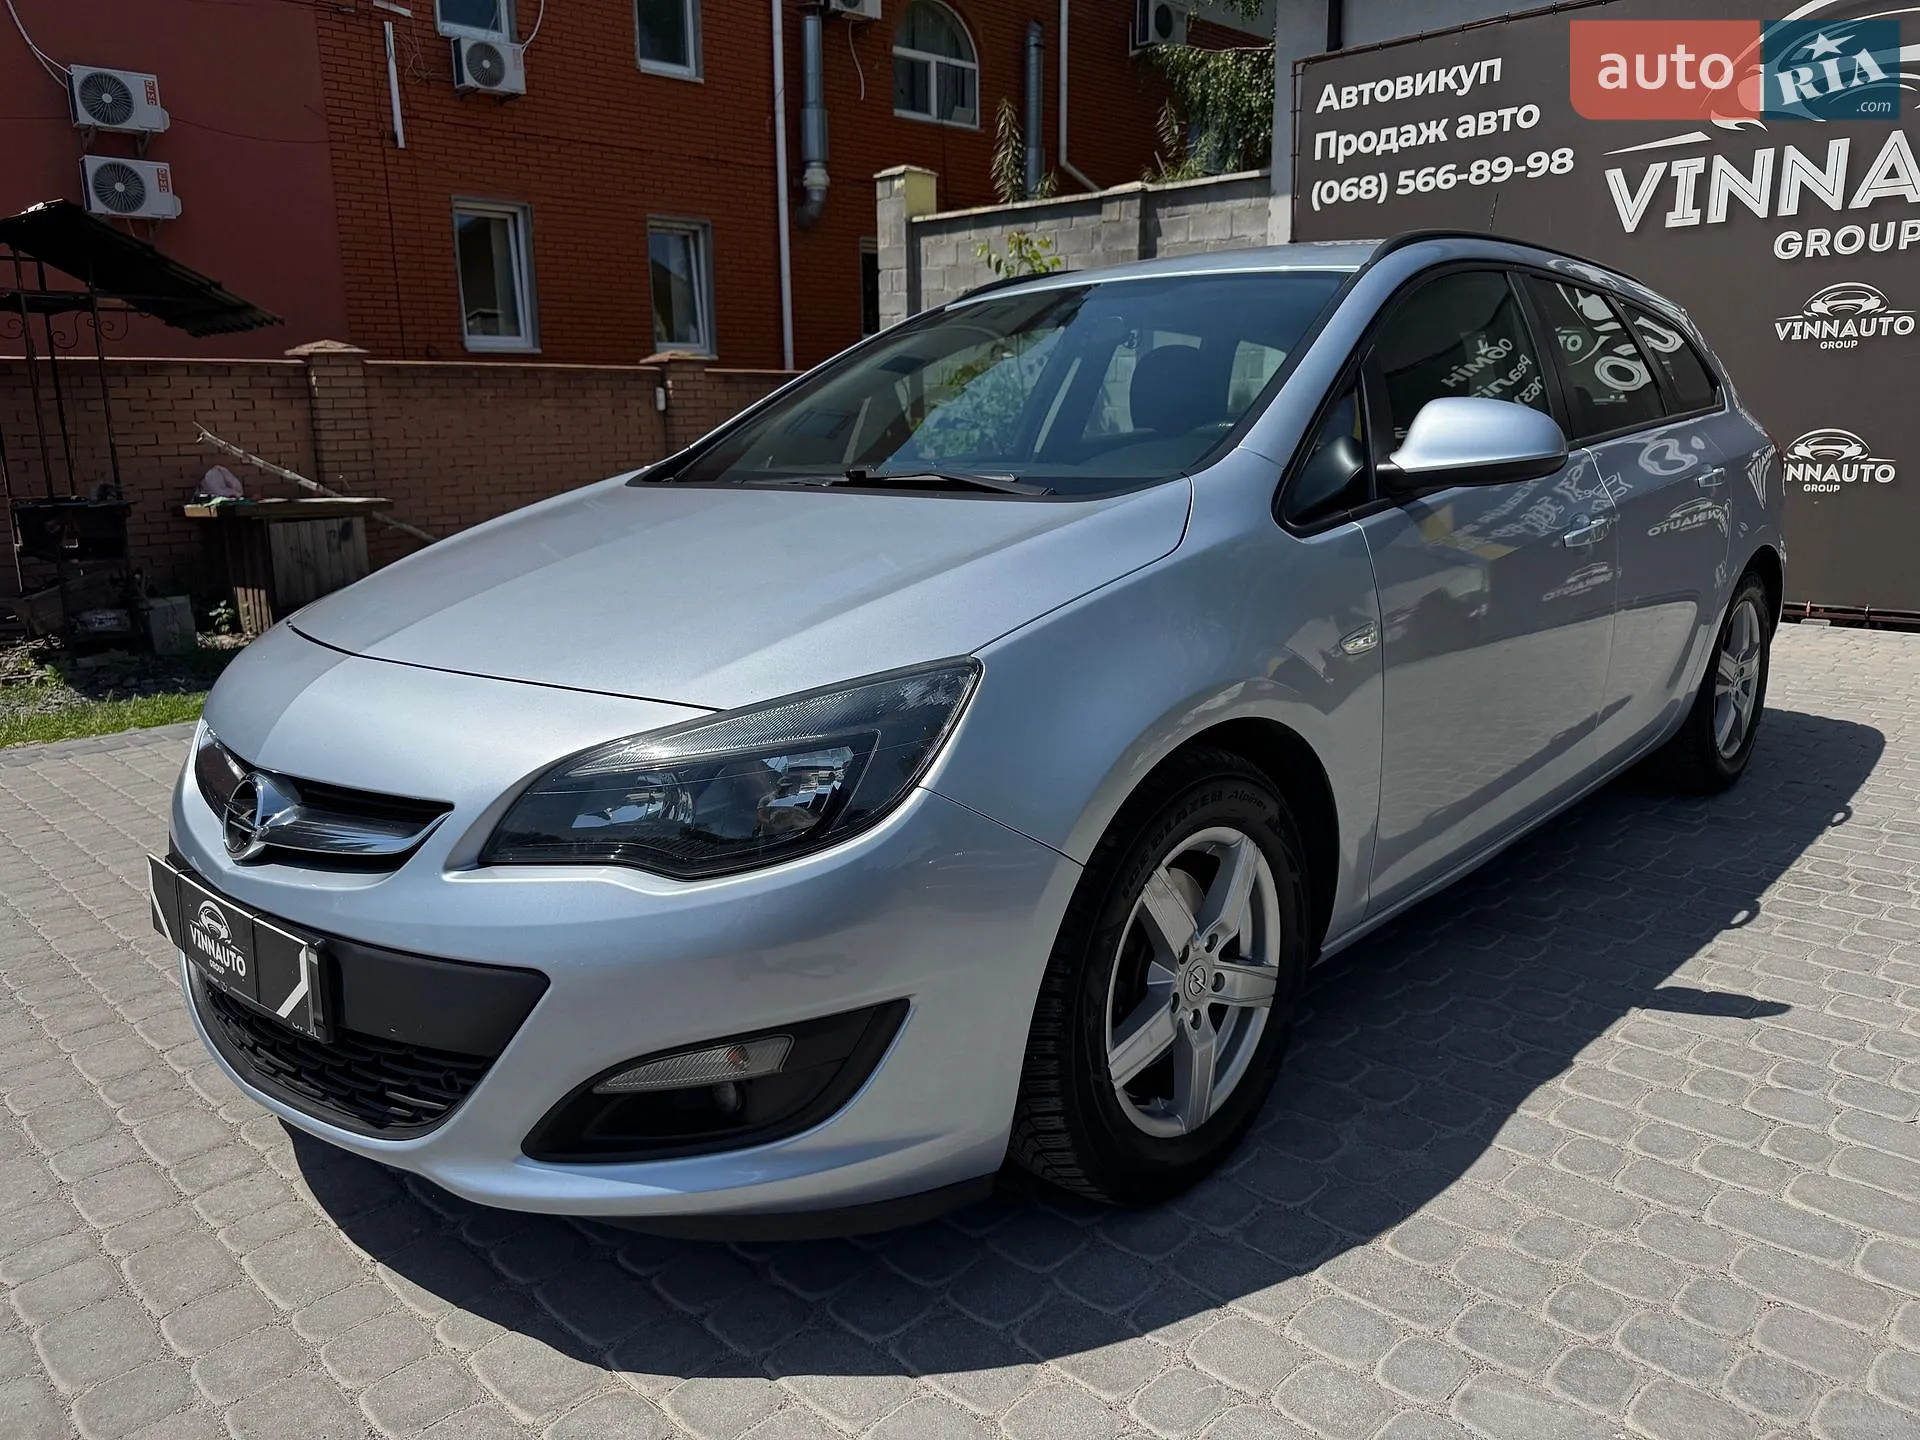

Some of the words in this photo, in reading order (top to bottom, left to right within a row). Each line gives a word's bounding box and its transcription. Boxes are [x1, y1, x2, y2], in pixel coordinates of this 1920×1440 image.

[1315, 56, 1502, 114] Автовикуп
[1314, 116, 1447, 164] Продаж
[1455, 103, 1541, 139] авто
[1311, 171, 1388, 211] (068)
[1396, 147, 1575, 196] 566-89-98
[1773, 219, 1920, 260] GROUP
[1774, 316, 1915, 341] VINNAUTO
[1820, 340, 1858, 350] GROUP
[1783, 463, 1896, 483] NNAUTO
[1803, 484, 1840, 493] GROUP
[190, 924, 246, 977] VINNAUTO
